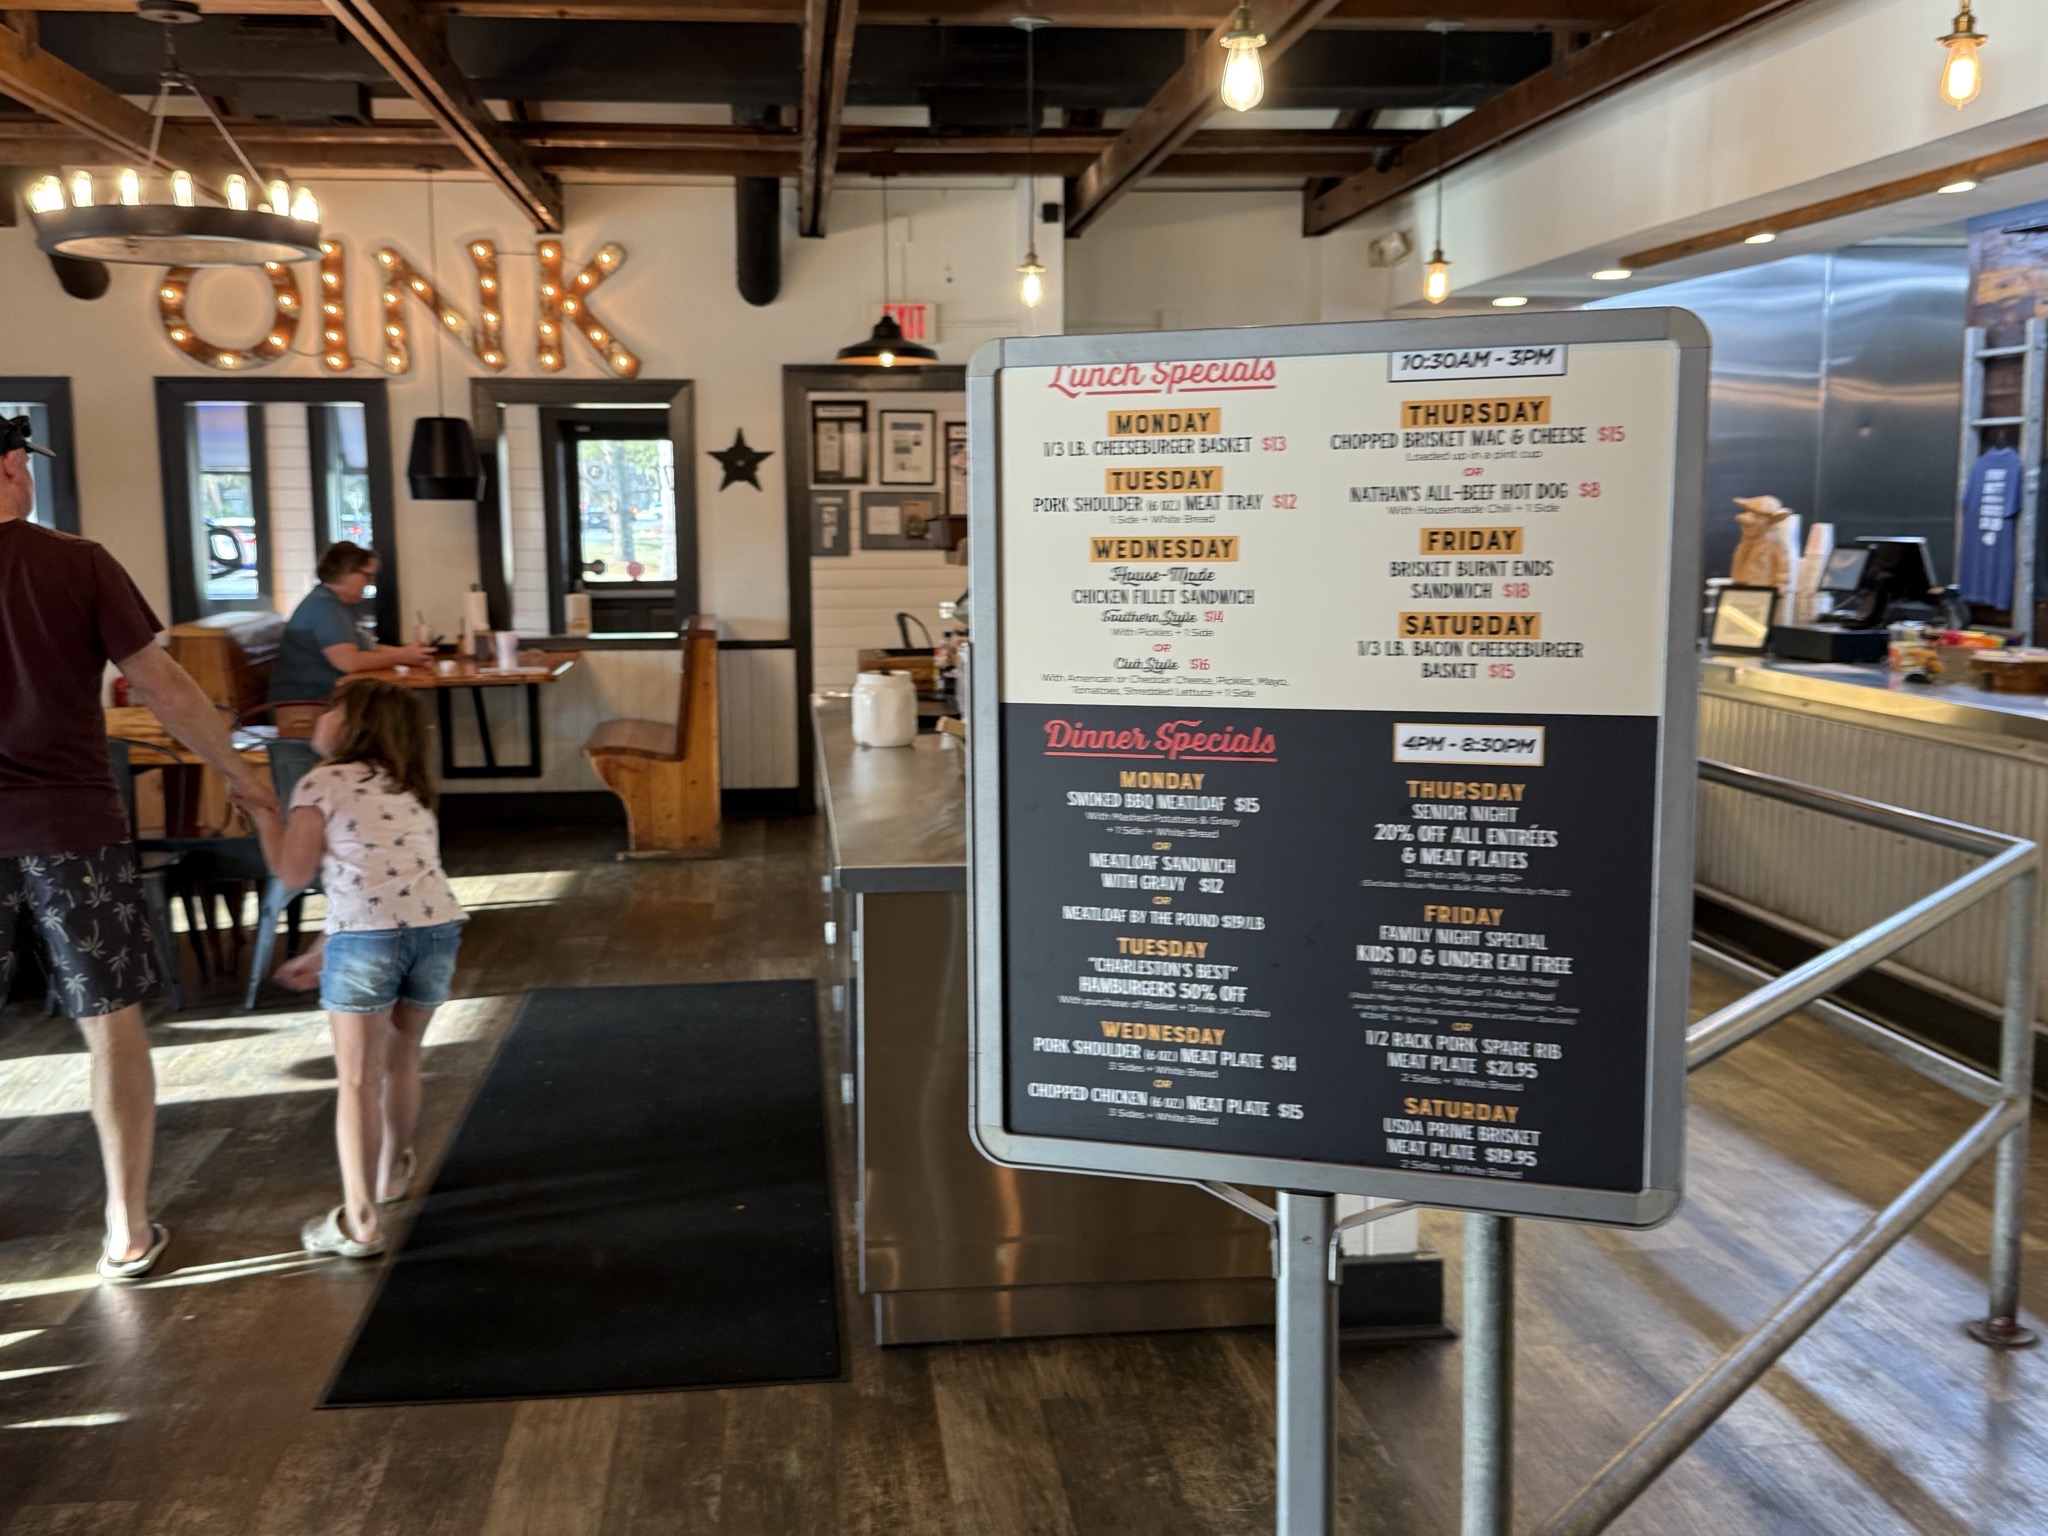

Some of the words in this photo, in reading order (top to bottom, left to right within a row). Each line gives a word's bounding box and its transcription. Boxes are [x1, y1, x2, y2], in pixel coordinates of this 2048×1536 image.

[160, 239, 641, 378] OINK
[1401, 351, 1490, 370] 10:30AM
[1509, 348, 1555, 366] 3PM
[1047, 364, 1145, 398] Lunch
[1152, 357, 1276, 394] Specials
[1115, 412, 1210, 434] MONDAY
[1409, 401, 1544, 425] THURSDAY
[1043, 441, 1064, 456] 1/3
[1068, 441, 1089, 455] LB.
[1092, 438, 1195, 455] CHEESEBURGER
[1199, 437, 1252, 454] BASKET
[1262, 436, 1287, 451] $13
[1330, 432, 1399, 450] CHOPPED
[1403, 430, 1465, 448] BRISKET
[1472, 429, 1505, 446] MAC
[1510, 428, 1523, 445] &
[1528, 426, 1587, 444] CHEESE
[1598, 426, 1626, 442] $15
[1112, 470, 1214, 491] TUESDAY
[1033, 498, 1069, 512] PORK
[1073, 496, 1143, 511] SHOULDER
[1185, 495, 1222, 510] MEAT
[1227, 494, 1263, 510] TRAY
[1273, 494, 1297, 509] $12
[1350, 485, 1421, 502] NATHAN'S
[1426, 483, 1496, 501] ALL-BEEF
[1502, 483, 1531, 499] HOT
[1536, 482, 1568, 499] DOG
[1578, 482, 1601, 497] $8
[1094, 539, 1233, 559] WEDNESDAY
[1427, 529, 1517, 551] FRIDAY
[1388, 561, 1452, 577] BRISKET
[1456, 561, 1508, 577] BURNT
[1512, 560, 1554, 577] ENDS
[1071, 589, 1129, 604] CHICKEN
[1132, 589, 1176, 604] FILLET
[1180, 589, 1255, 604] SANDWICH
[1410, 583, 1493, 599] SANDWICH
[1502, 583, 1530, 598] $18
[1405, 614, 1535, 636] SATURDAY
[1357, 641, 1381, 656] 1/3
[1384, 641, 1408, 656] LB.
[1412, 641, 1463, 657] BACON
[1466, 642, 1584, 658] CHEESEBURGER
[1421, 663, 1479, 679] BASKET
[1488, 664, 1515, 679] $15
[1043, 719, 1151, 750] Dinner
[1153, 720, 1277, 759] Specials
[1402, 736, 1447, 751] 4PM
[1460, 737, 1537, 754] 8:30PM
[1119, 771, 1205, 790] MONDAY
[1405, 779, 1526, 802] THURSDAY
[1066, 791, 1122, 807] SMOKED
[1124, 793, 1154, 809] BBQ
[1156, 794, 1227, 812] MEATLOAF
[1234, 797, 1260, 813] $15
[1411, 803, 1467, 821] SENIOR
[1470, 805, 1519, 823] NIGHT
[1374, 823, 1415, 842] 20%
[1416, 825, 1448, 843] OFF
[1450, 827, 1483, 845] ALL
[1486, 824, 1559, 848] ENTRÉES
[1089, 852, 1159, 870] MEATLOAF
[1162, 856, 1236, 873] SANDWICH
[1401, 847, 1416, 864] &
[1419, 848, 1464, 866] MEAT
[1467, 849, 1529, 869] PLATES
[1101, 873, 1138, 889] WITH
[1140, 875, 1187, 891] GRAVY
[1199, 878, 1225, 893] $12
[1423, 904, 1504, 926] FRIDAY
[1116, 937, 1208, 958] TUESDAY
[1379, 925, 1433, 943] FAMILY
[1435, 928, 1483, 946] NIGHT
[1484, 931, 1548, 950] SPECIAL
[1356, 944, 1394, 963] KIDS
[1397, 947, 1417, 964] 10
[1419, 949, 1435, 965] &
[1438, 949, 1494, 969] UNDER
[1496, 953, 1529, 971] EAT
[1531, 955, 1574, 975] FREE
[1078, 976, 1176, 998] HAMBURGERS
[1179, 983, 1217, 1001] 50%
[1219, 985, 1248, 1002] OFF
[1100, 1020, 1225, 1045] WEDNESDAY
[1033, 1037, 1070, 1054] PORK
[1072, 1039, 1142, 1060] SHOULDER
[1180, 1048, 1218, 1066] MEAT
[1220, 1051, 1264, 1069] PLATE
[1271, 1055, 1297, 1071] $14
[1365, 1030, 1389, 1047] 1/2
[1391, 1031, 1433, 1049] RACK
[1436, 1034, 1478, 1053] PORK
[1481, 1038, 1531, 1057] SPARE
[1533, 1043, 1563, 1060] RIB
[1387, 1052, 1428, 1069] MEAT
[1431, 1055, 1477, 1074] PLATE
[1485, 1059, 1539, 1079] $21.95
[1027, 1082, 1088, 1101] CHOPPED
[1090, 1087, 1148, 1106] CHICKEN
[1186, 1095, 1225, 1113] MEAT
[1226, 1099, 1271, 1117] PLATE
[1277, 1103, 1304, 1120] $15
[1404, 1097, 1520, 1123] SATURDAY
[1383, 1117, 1424, 1135] USDA
[1427, 1121, 1474, 1140] PRIME
[1477, 1125, 1542, 1146] BRISKET
[1386, 1138, 1427, 1156] MEAT
[1429, 1142, 1477, 1161] PLATE
[1484, 1146, 1538, 1167] $19.95
